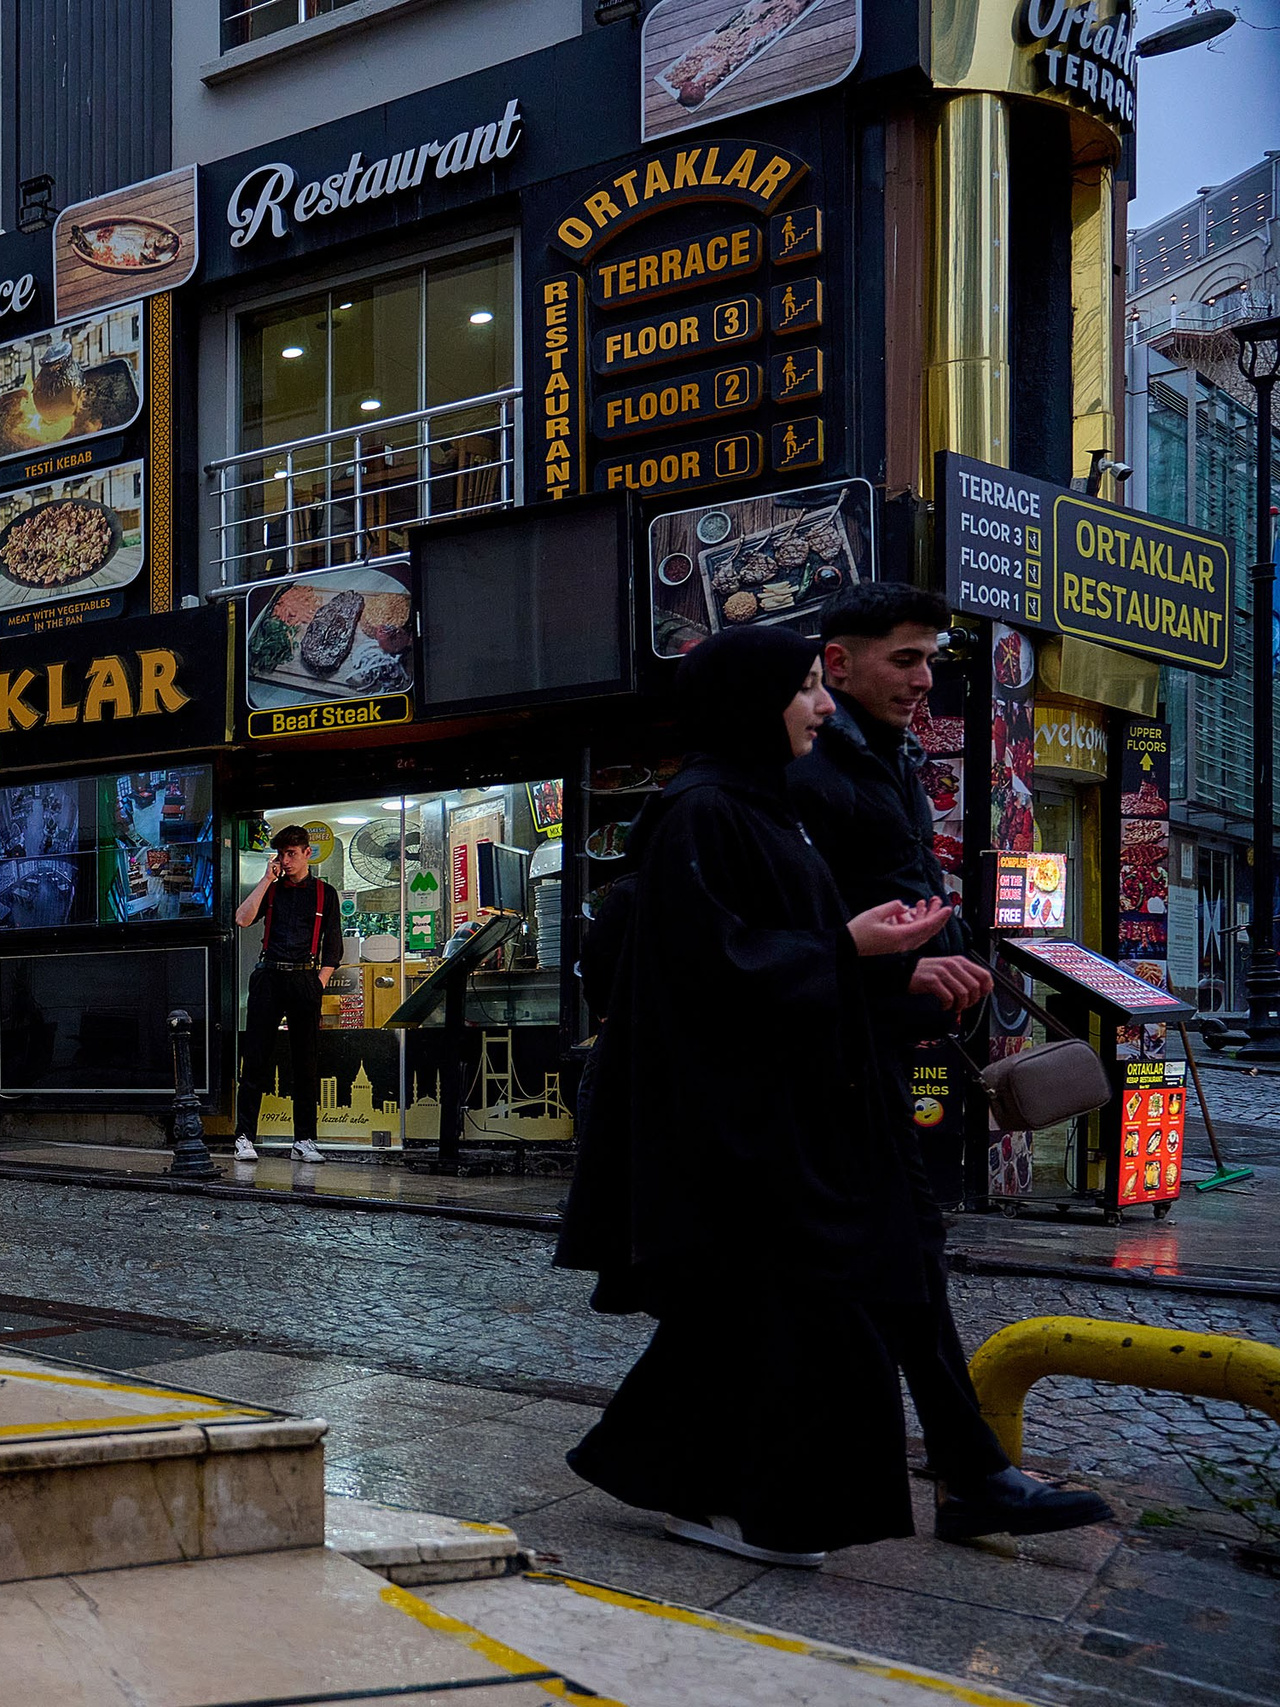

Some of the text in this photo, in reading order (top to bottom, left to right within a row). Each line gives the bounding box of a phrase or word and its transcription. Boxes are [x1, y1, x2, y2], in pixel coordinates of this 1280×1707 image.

[1028, 0, 1135, 82] Ortakl
[227, 98, 522, 248] Restaurant
[558, 147, 791, 249] ORTAKLAR
[599, 229, 751, 299] TERRACE
[606, 306, 740, 364] FLOOR 3
[544, 280, 570, 501] RESTAURANT
[607, 373, 740, 429] FLOOR 2
[57, 450, 93, 472] KEBAB
[608, 442, 736, 490] FLOOR 1
[959, 471, 1040, 519] TERRACE
[961, 512, 1022, 546] FLOOR 3
[961, 546, 1022, 580] FLOOR 2
[1076, 519, 1216, 593] ORTAKLAR
[8, 610, 30, 626] MEAT
[57, 598, 111, 618] VEGETABLES
[961, 580, 1019, 612] FLOOR 1
[1063, 571, 1223, 648] RESTAURANT
[45, 617, 64, 630] THE
[65, 613, 84, 628] PAN
[273, 701, 382, 732] Beaf Steak
[1129, 726, 1162, 739] UPPER
[1127, 740, 1167, 753] FLOORS
[999, 908, 1022, 923] FREE
[1127, 1062, 1164, 1076] ORTAKLAR
